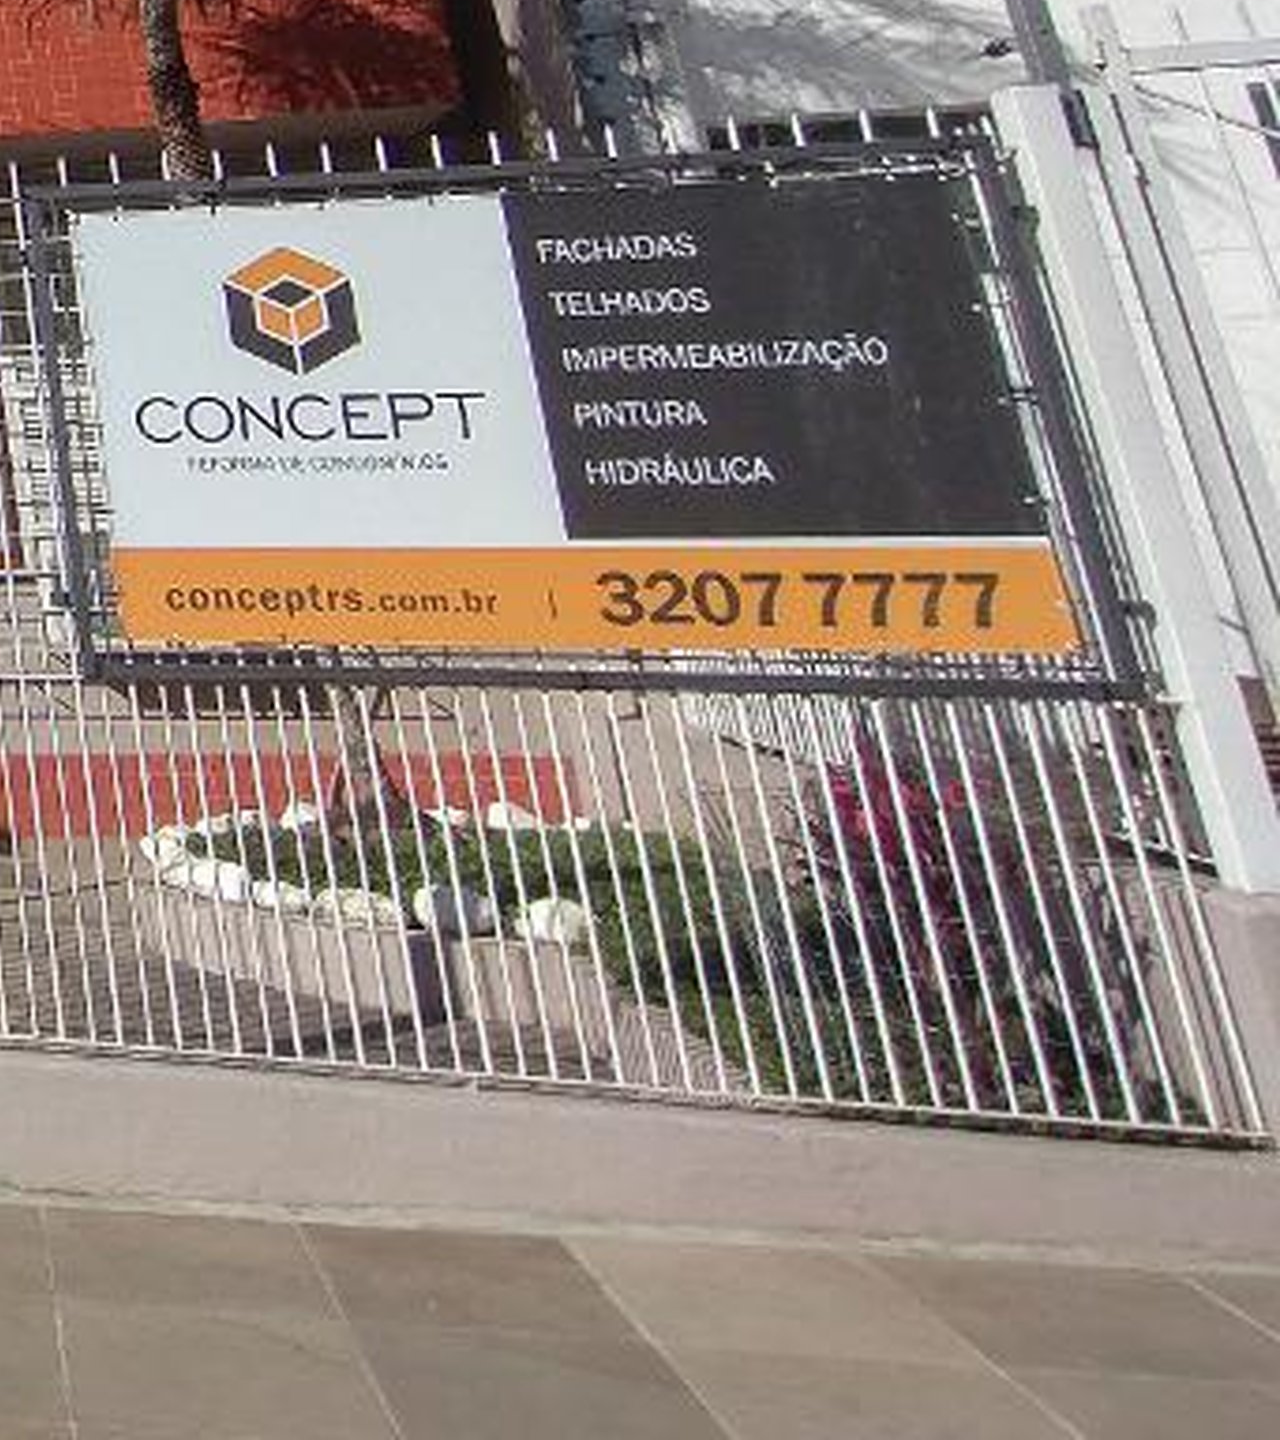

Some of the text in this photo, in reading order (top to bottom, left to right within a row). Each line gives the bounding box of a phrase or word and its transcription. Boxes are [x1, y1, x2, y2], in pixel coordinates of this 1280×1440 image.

[536, 232, 698, 263] FACHADAS
[548, 287, 711, 316] TELHADOS
[561, 334, 889, 371] IMPERMEABILIZAÇÃO
[135, 393, 485, 443] CONCEPT
[573, 400, 708, 428] PINTURA
[585, 454, 776, 485] HIDRÁULICA
[165, 584, 497, 617] conceptrs.com.br
